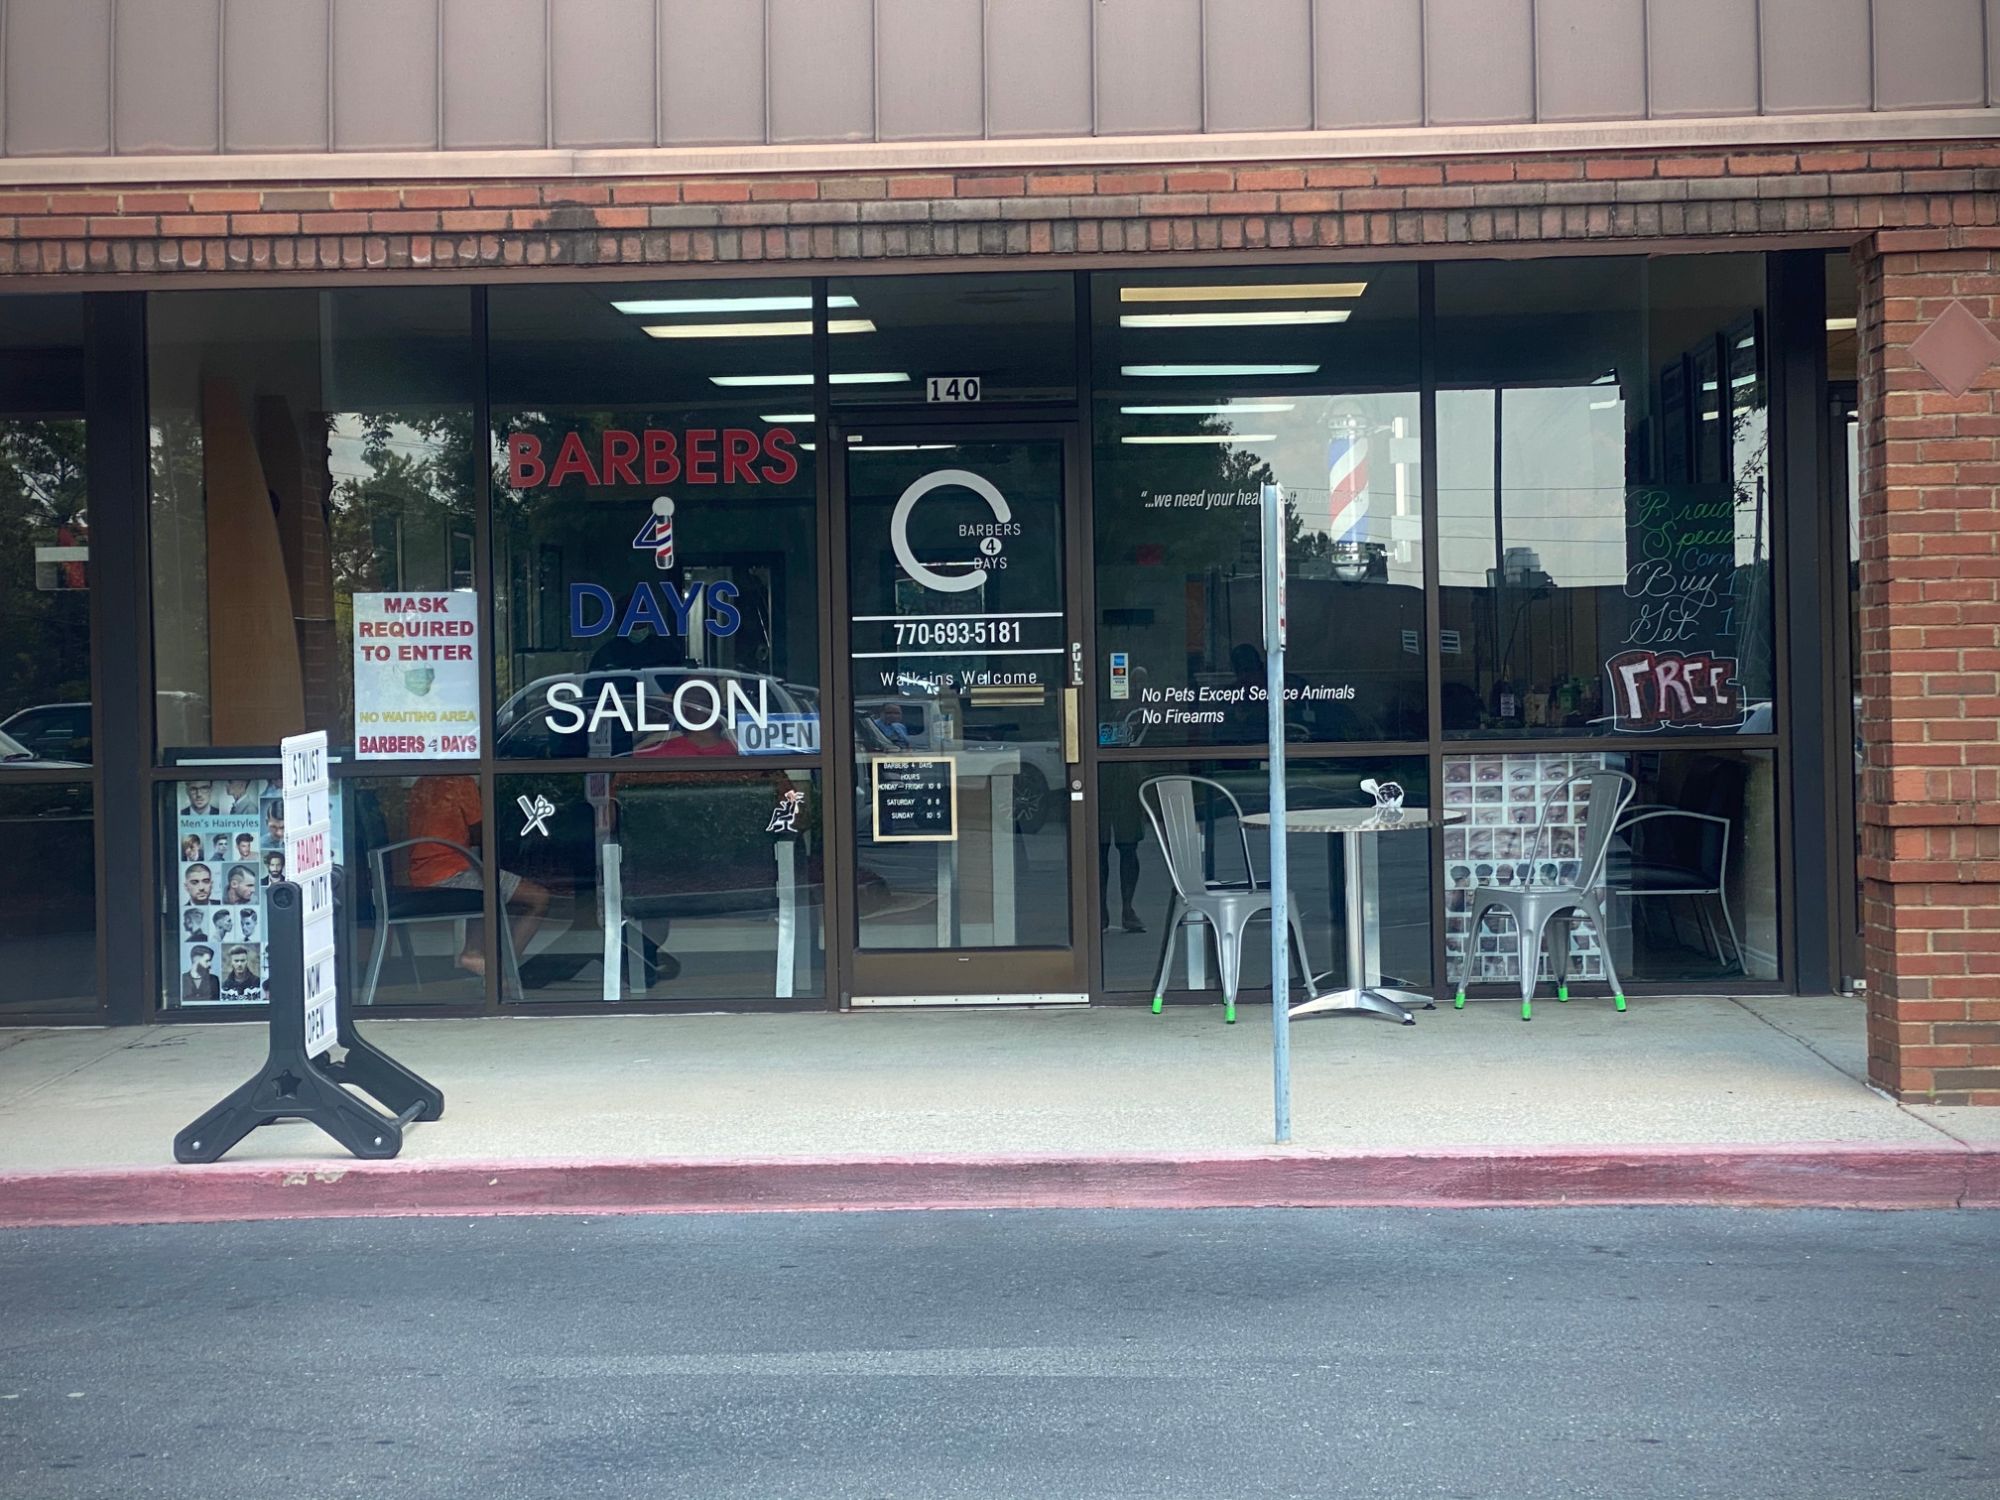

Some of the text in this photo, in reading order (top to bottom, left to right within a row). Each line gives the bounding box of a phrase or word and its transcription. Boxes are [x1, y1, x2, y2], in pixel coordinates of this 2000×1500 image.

[931, 379, 979, 401] 140
[508, 428, 798, 488] BARBERS
[1174, 490, 1204, 507] need
[1205, 491, 1235, 510] your
[632, 496, 675, 569] 4
[958, 523, 1021, 537] BARBERS
[973, 557, 1007, 570] DAYS
[1623, 558, 1718, 618] Buy
[384, 597, 448, 613] MASK
[569, 580, 741, 638] DAYS
[359, 621, 474, 638] REQUIRED
[893, 621, 1021, 645] 770-693-5181
[1621, 602, 1737, 645] Get 1
[361, 645, 473, 661] TO ENTER
[1071, 643, 1082, 683] PULL
[880, 669, 1037, 686] Walk-ins Welcome
[1618, 659, 1730, 719] FREE
[1142, 688, 1161, 702] No
[1164, 687, 1195, 702] Pets
[1199, 686, 1245, 704] Except
[1301, 684, 1355, 700] Animals
[359, 711, 476, 723] NO WAITING AREA
[545, 679, 768, 734] SALON
[1142, 710, 1224, 724] No Firearms
[359, 735, 425, 753] BARBERS
[441, 735, 477, 753] DAYS
[745, 722, 813, 750] OPEN
[293, 749, 319, 786] STYLIST
[180, 819, 259, 829] Men's Hairstyles
[307, 963, 321, 999] NOW
[308, 1006, 325, 1044] OPEN
